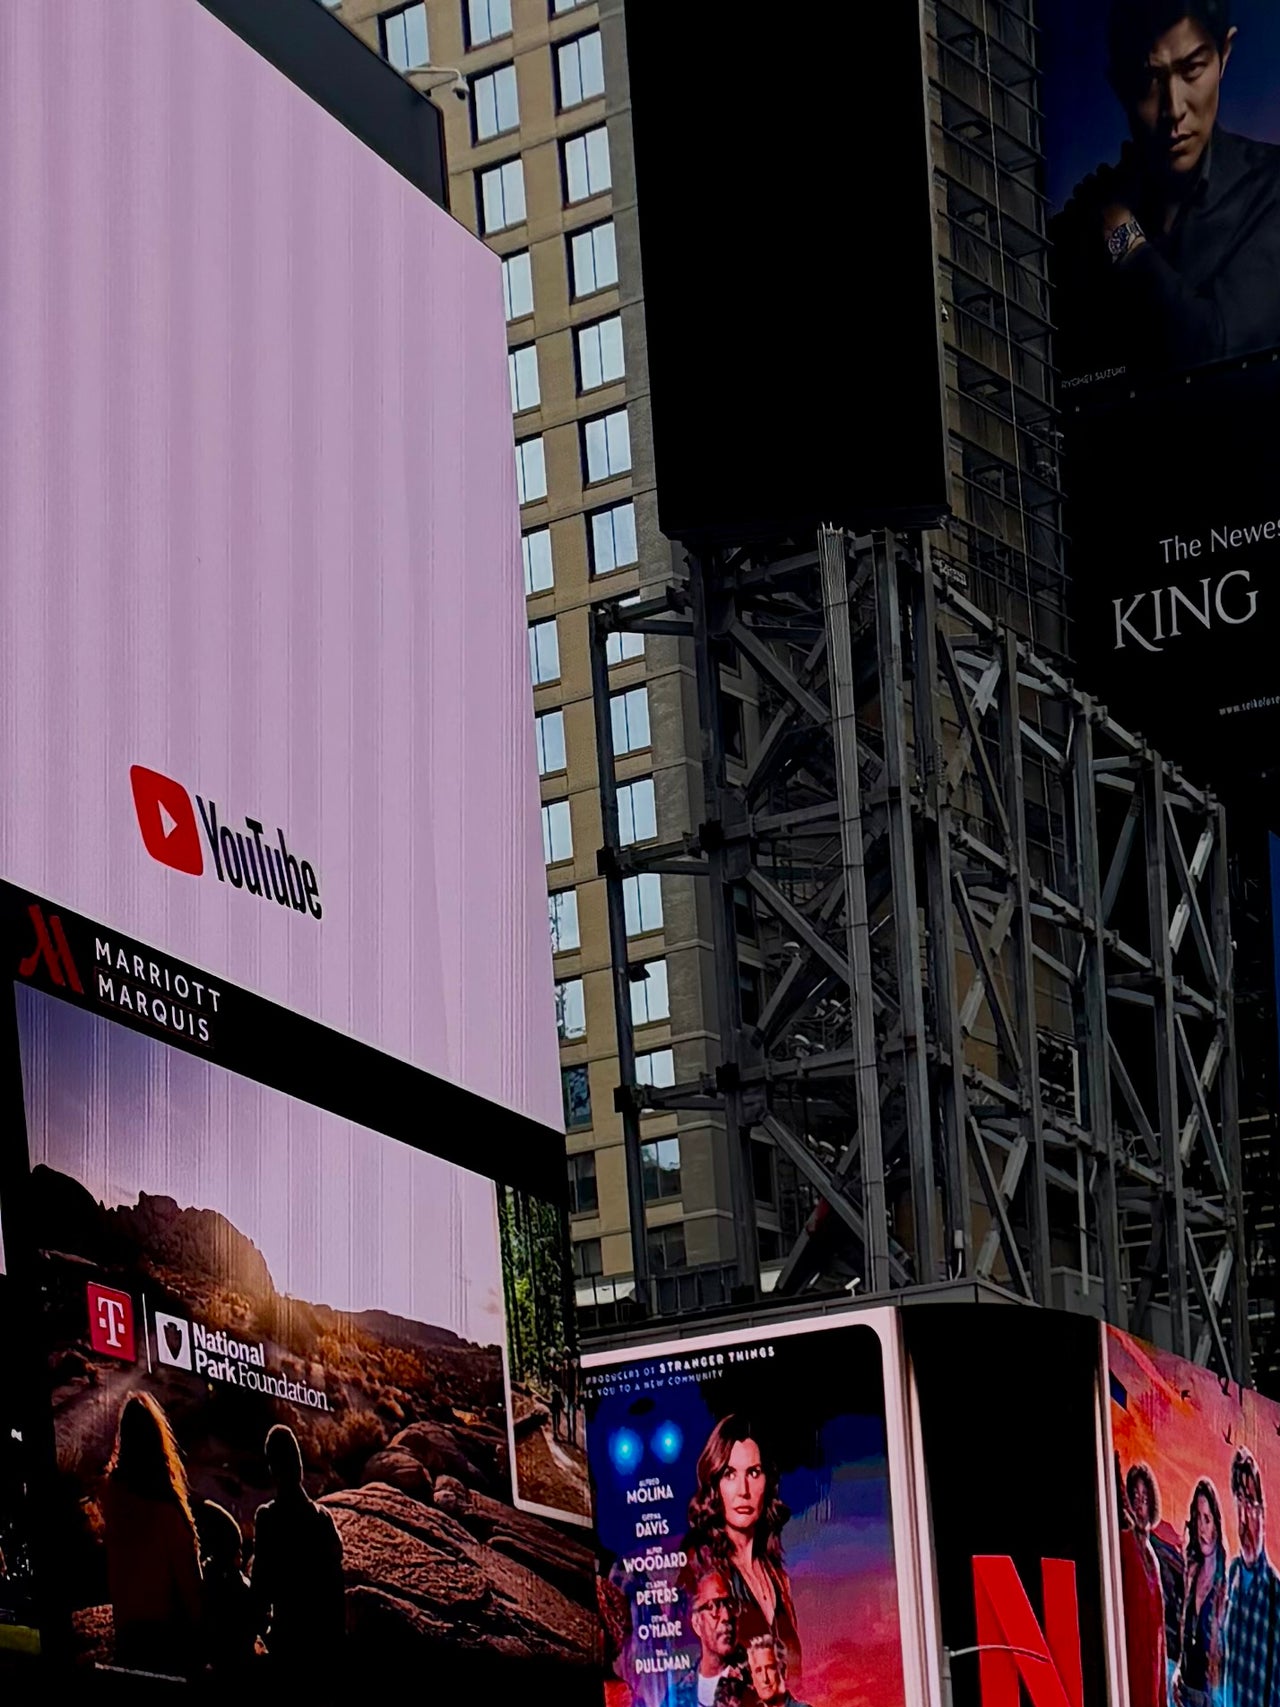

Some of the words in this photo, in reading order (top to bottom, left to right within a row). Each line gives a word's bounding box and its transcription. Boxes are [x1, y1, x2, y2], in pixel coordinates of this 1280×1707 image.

[1158, 530, 1203, 566] The
[1110, 569, 1262, 654] KING
[196, 794, 324, 921] YouTube
[94, 938, 221, 1014] MARRIOTT
[96, 972, 213, 1043] MARQUIS
[97, 1296, 126, 1348] T
[191, 1321, 267, 1368] National
[658, 1352, 724, 1374] STRANGER
[728, 1345, 776, 1364] THINGS
[194, 1349, 239, 1385] Park
[667, 1369, 724, 1386] COMMUNITY
[625, 1483, 675, 1505] MOLINA
[635, 1518, 671, 1538] DAVIS
[622, 1550, 689, 1574] WOODARD
[636, 1587, 680, 1606] PETERS
[638, 1619, 683, 1640] O'HARE
[635, 1653, 692, 1675] PULLMAN
